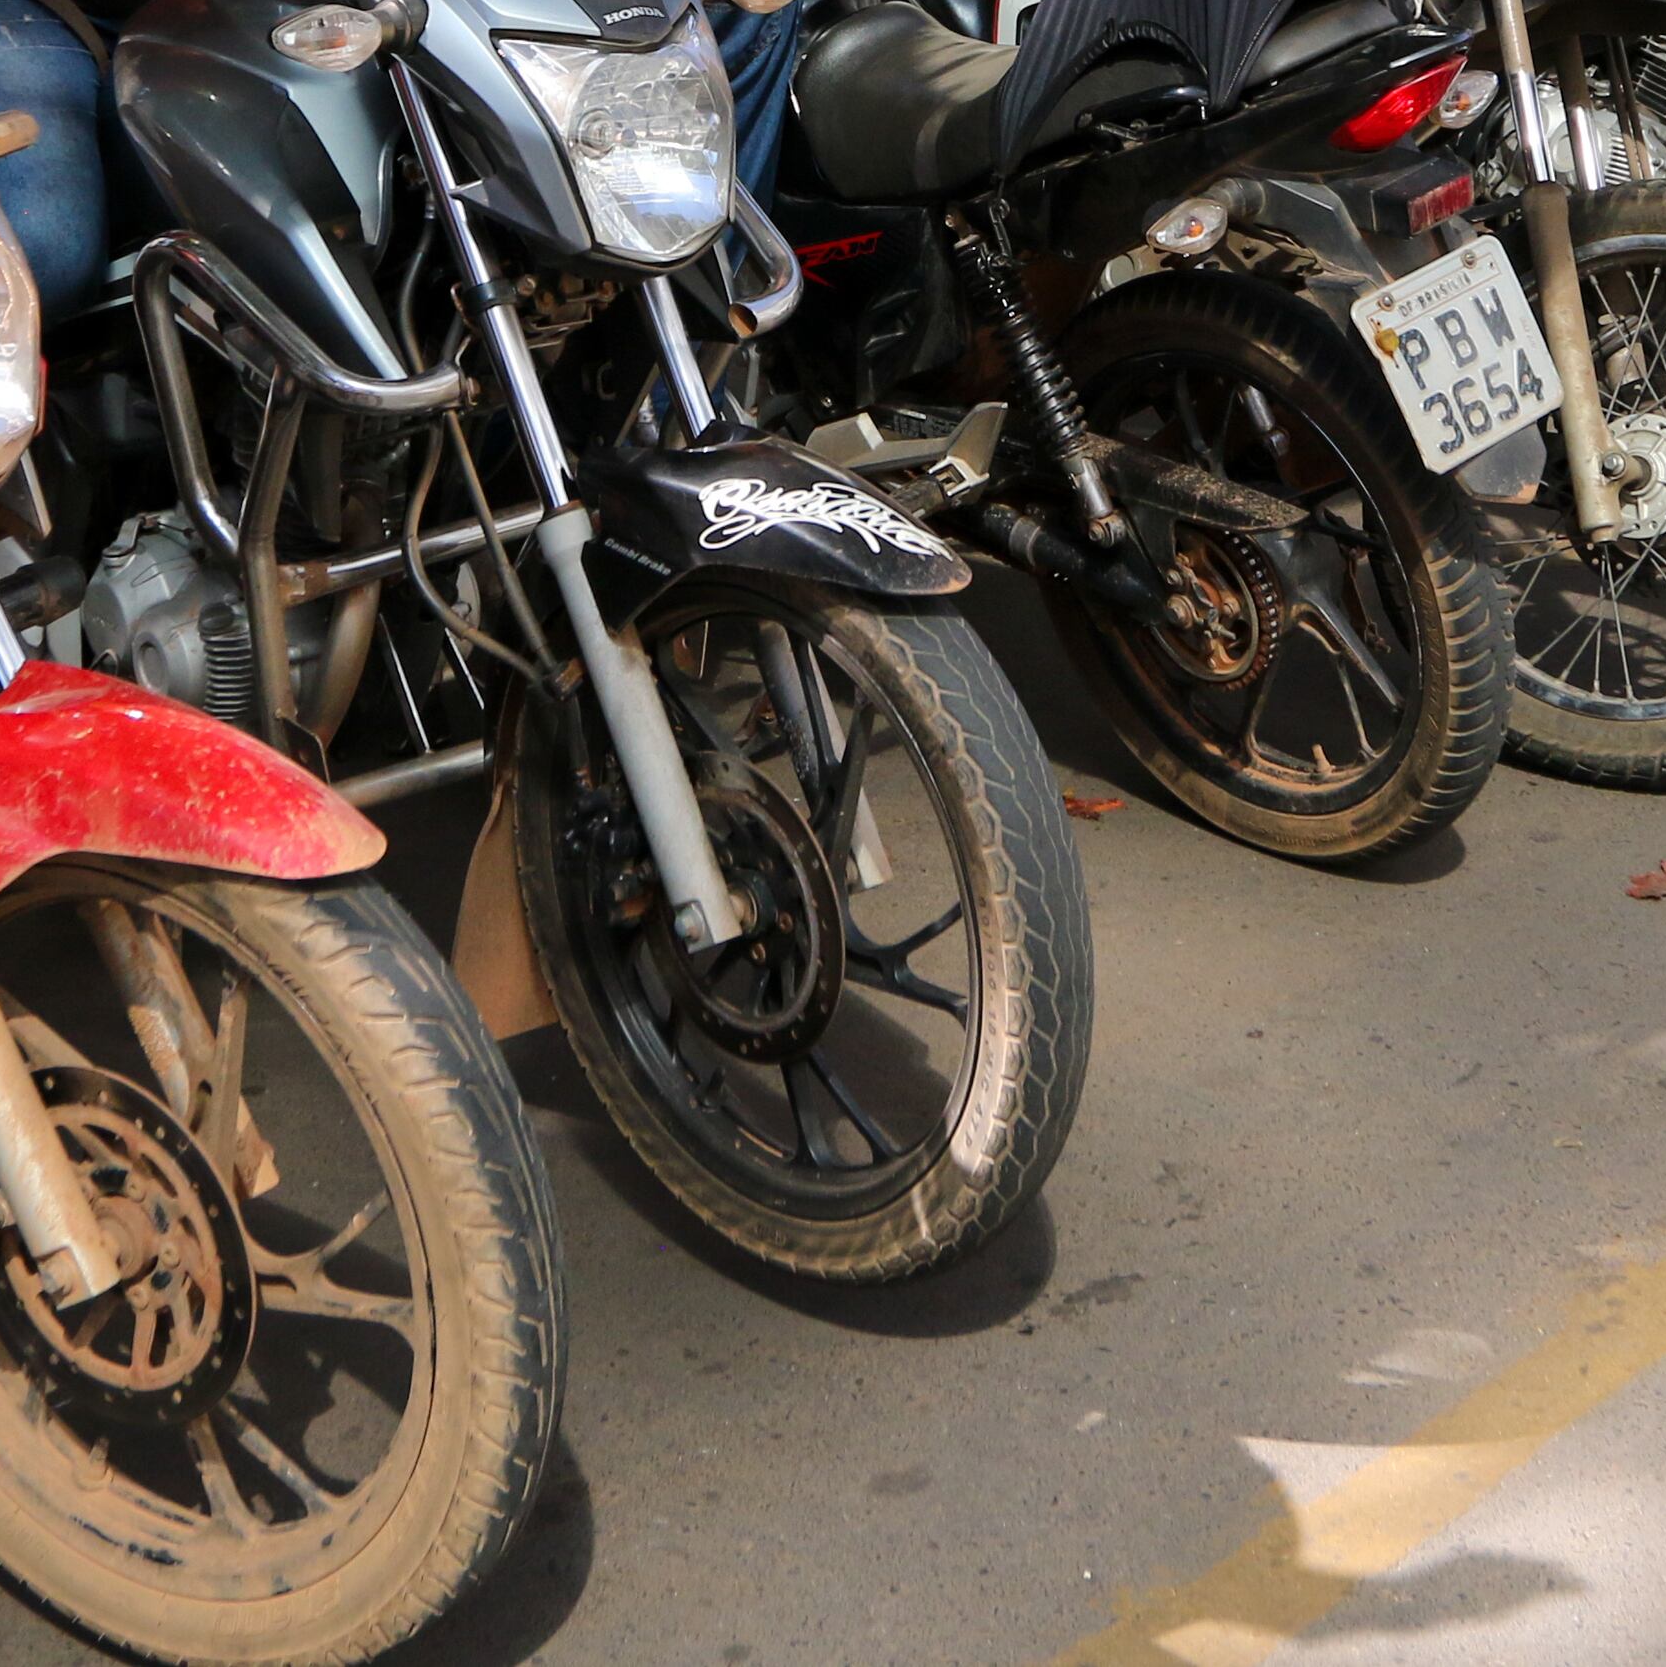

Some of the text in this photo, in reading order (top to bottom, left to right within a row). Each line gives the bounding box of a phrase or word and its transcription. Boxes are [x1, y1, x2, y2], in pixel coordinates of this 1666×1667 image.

[603, 6, 666, 25] HONDA
[1398, 287, 1516, 391] PBW
[1423, 347, 1545, 455] 3654
[637, 553, 672, 577] Brake
